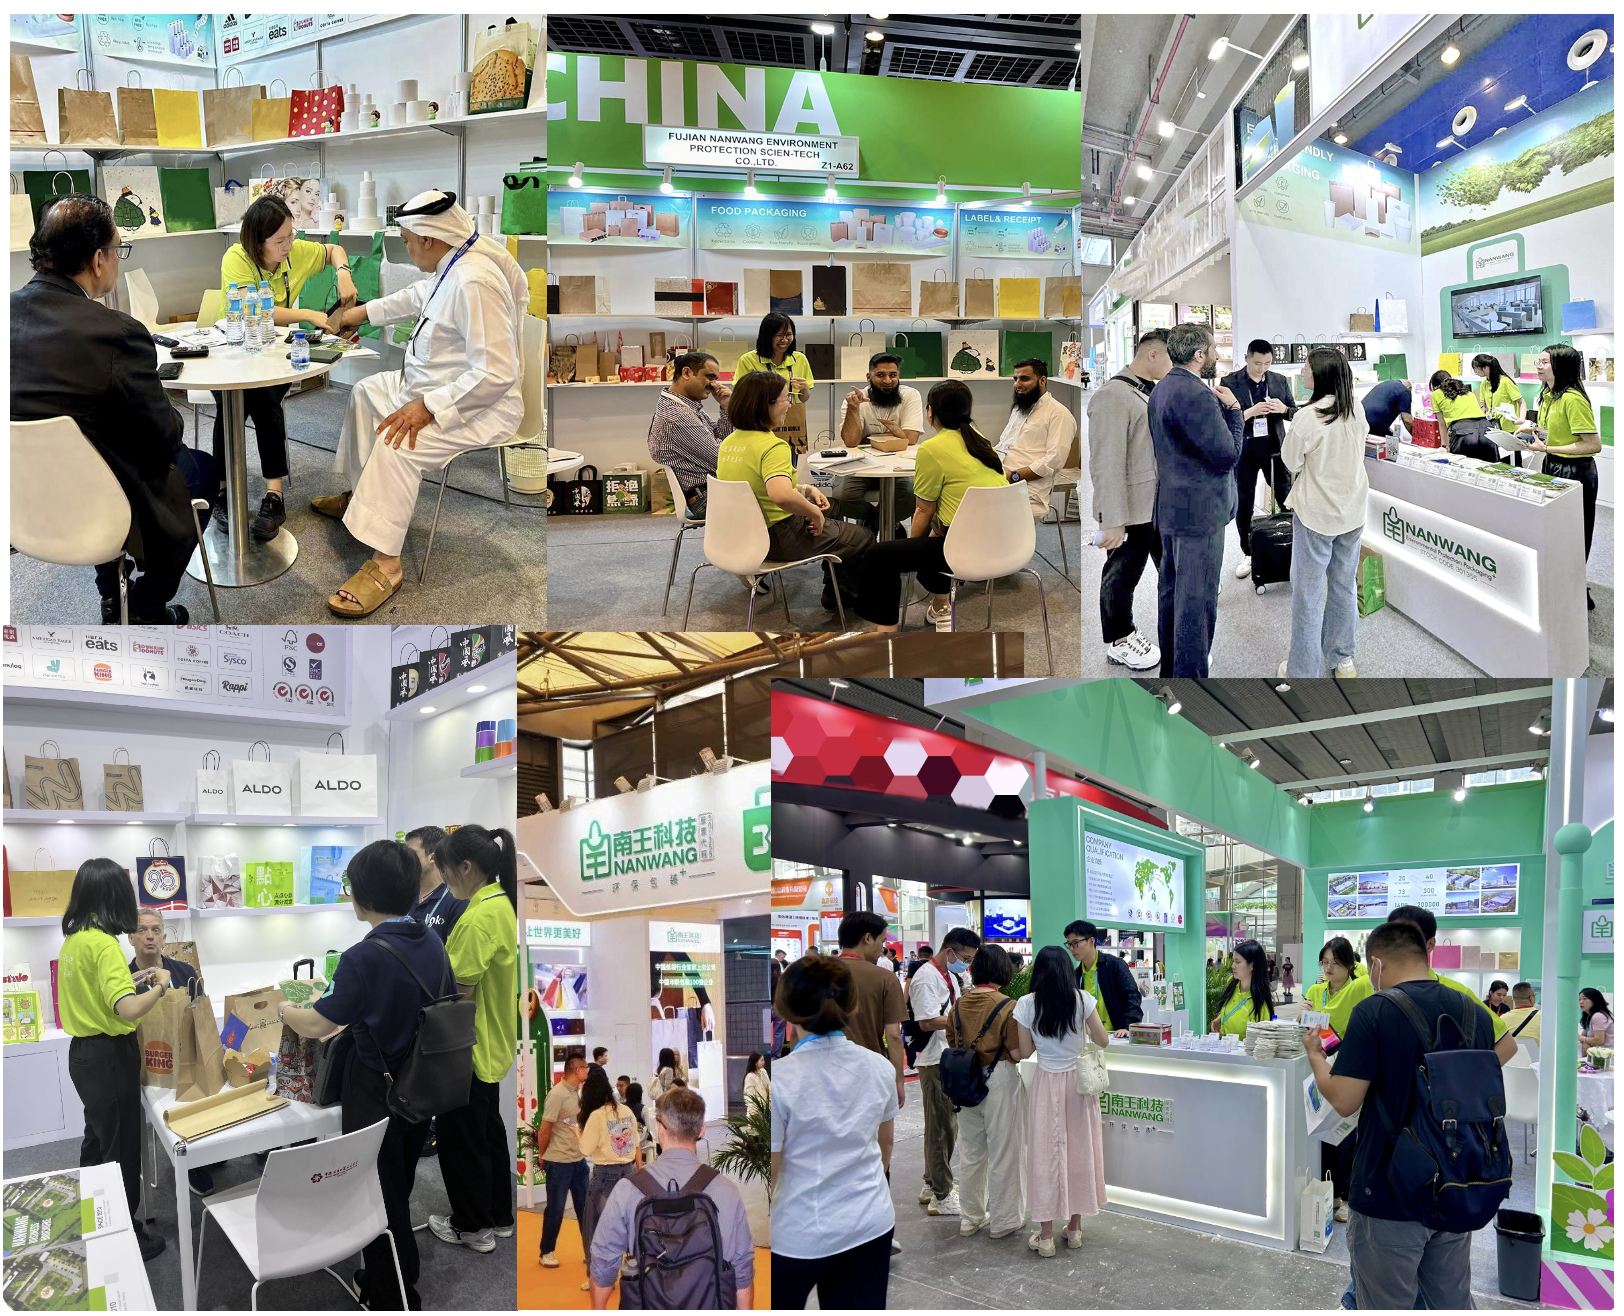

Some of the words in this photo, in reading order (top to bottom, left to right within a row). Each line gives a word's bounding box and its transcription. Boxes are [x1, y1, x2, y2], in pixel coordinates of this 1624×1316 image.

[268, 26, 287, 40] eats
[668, 132, 707, 142] FUJIAN
[709, 134, 763, 146] NANWANG
[766, 137, 838, 150] ENVIRONMENT
[689, 144, 757, 155] PROTECTION
[760, 148, 820, 159] SCIEN-TECH
[735, 157, 777, 167] CO.,LTD.
[821, 161, 854, 171] Z1-A62
[711, 206, 742, 216] FOOD
[744, 207, 807, 218] PACKAGING
[965, 214, 1001, 223] LABEL&
[1003, 215, 1042, 225] RECEIPT
[1484, 252, 1515, 263] NANWANG
[1406, 521, 1497, 574] NANWANG
[1406, 535, 1437, 555] Environmental
[1438, 549, 1463, 567] Protection
[1420, 549, 1437, 562] STOCK
[1438, 557, 1455, 571] CODE
[219, 630, 250, 638] COACH
[85, 639, 118, 652] eats
[223, 654, 247, 666] Sysco
[221, 679, 249, 694] Rappi
[241, 784, 283, 794] ALDO
[314, 780, 362, 791] ALDO
[613, 816, 697, 858] 南王科技
[1086, 835, 1112, 849] COMPANY
[1086, 845, 1124, 861] QUALIFICATION
[614, 847, 698, 876] NANWANG
[145, 1049, 173, 1060] BURGER
[145, 1057, 173, 1070] KING
[1111, 1094, 1164, 1113] 南王科技
[1111, 1107, 1164, 1122] NANWANG
[12, 1215, 29, 1248] NANWANG
